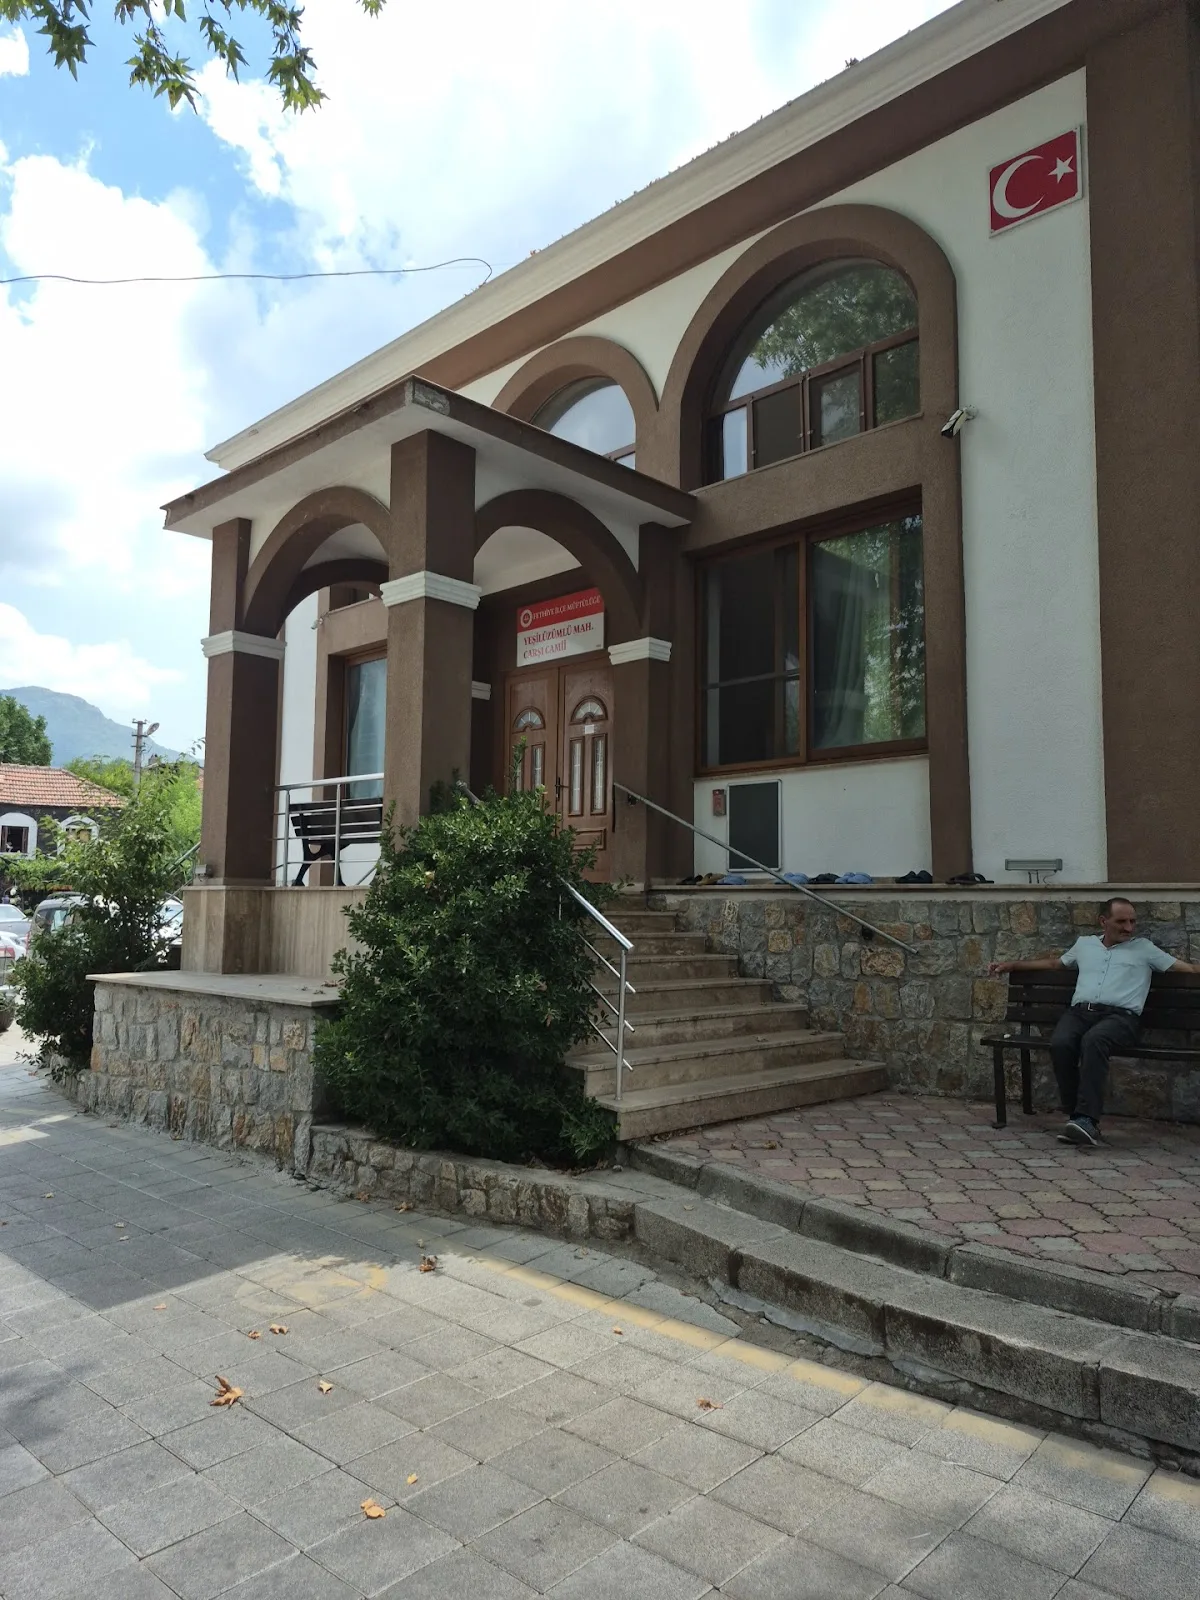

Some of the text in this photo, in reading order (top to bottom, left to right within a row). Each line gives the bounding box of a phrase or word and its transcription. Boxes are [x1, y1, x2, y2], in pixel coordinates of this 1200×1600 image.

[533, 608, 554, 620] FETHİYE
[523, 622, 594, 646] YEŞİLÜZÜMLÜ MAH.
[545, 639, 567, 653] CAMİİ
